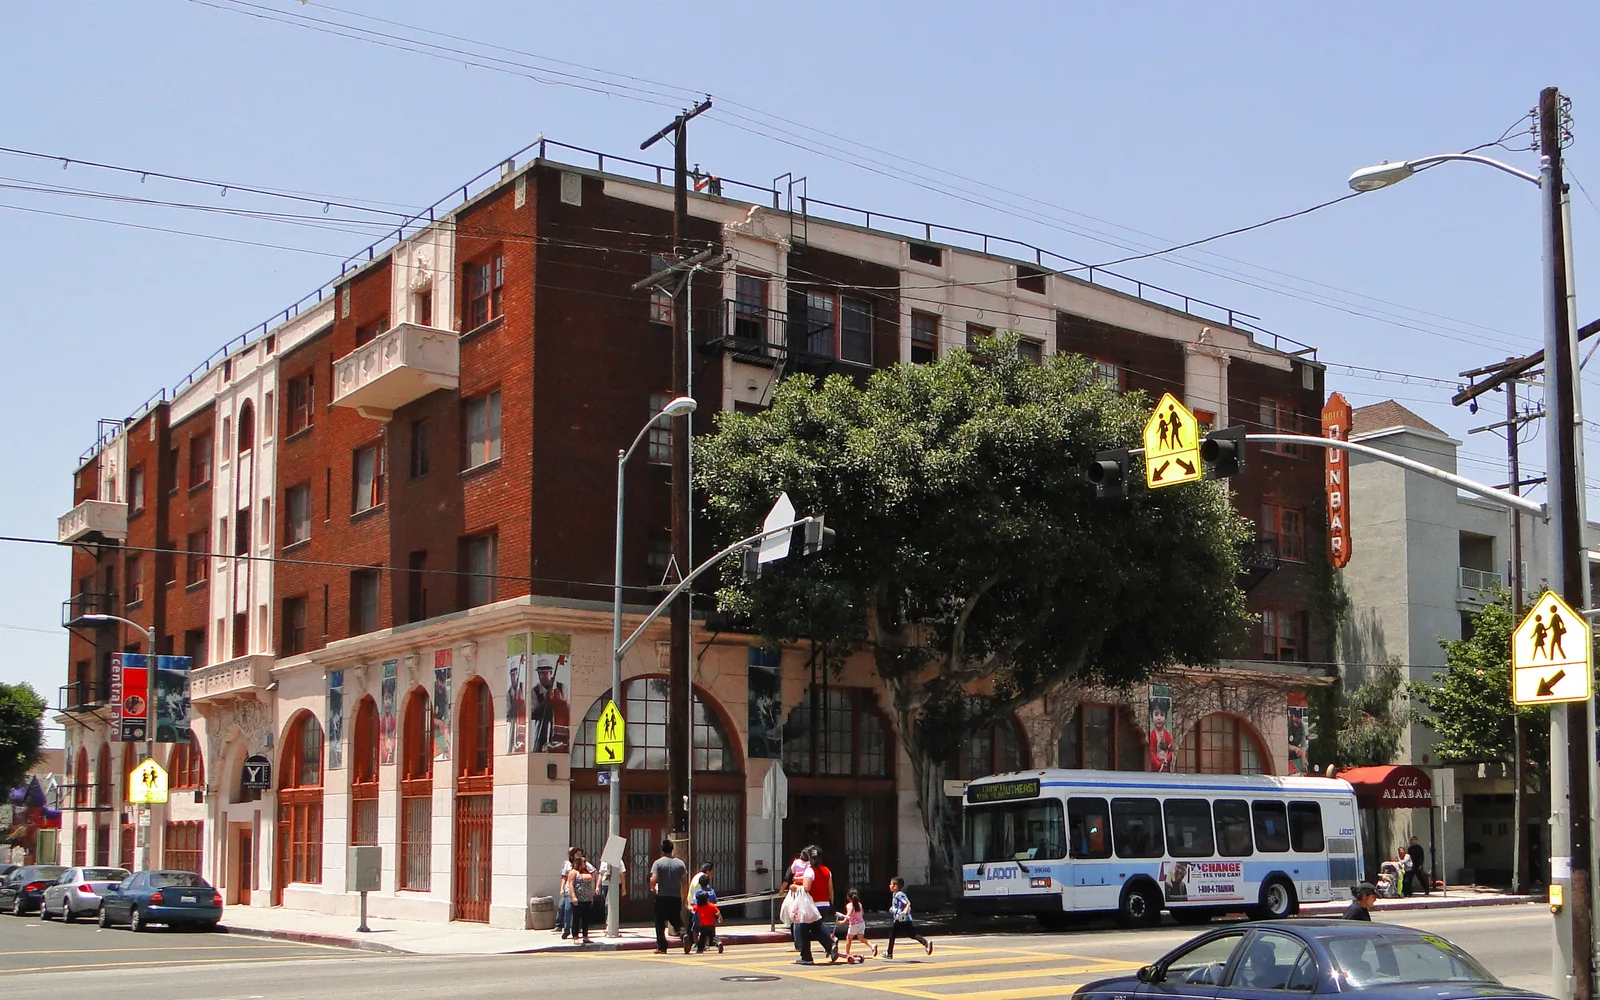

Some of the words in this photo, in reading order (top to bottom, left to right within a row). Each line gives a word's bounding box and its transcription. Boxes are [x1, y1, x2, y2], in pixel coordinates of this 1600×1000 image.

[1323, 409, 1344, 421] HOTEL
[1328, 424, 1343, 553] DUNBAR
[111, 658, 122, 707] central
[111, 712, 120, 735] ave
[1397, 776, 1418, 786] Club
[986, 866, 1019, 880] LADOT
[1201, 862, 1241, 872] CHANGE
